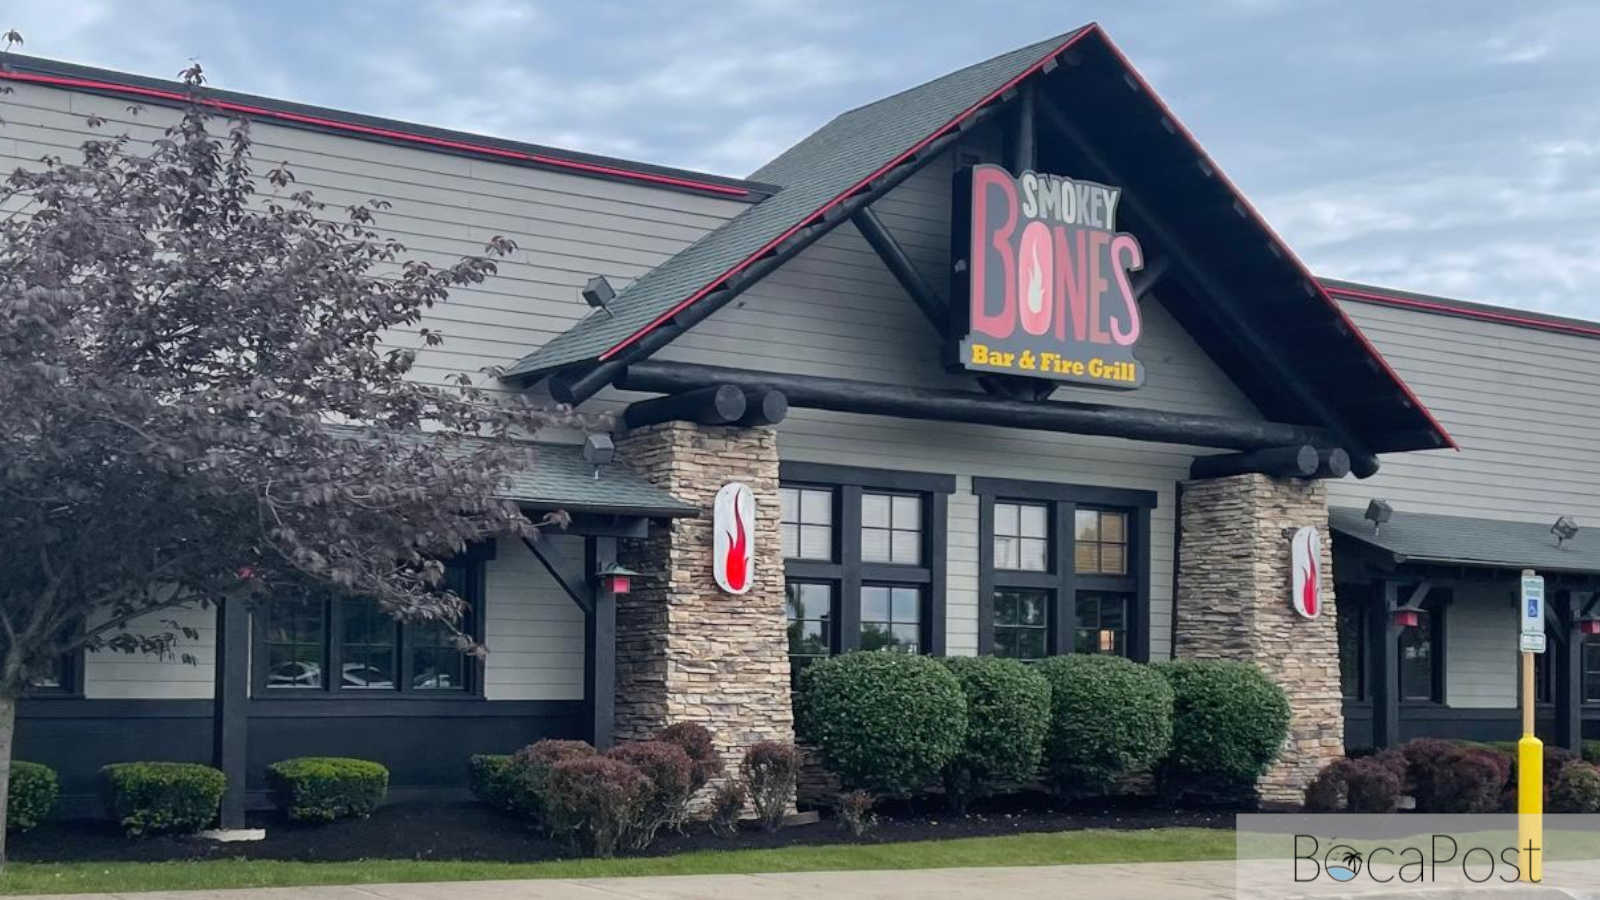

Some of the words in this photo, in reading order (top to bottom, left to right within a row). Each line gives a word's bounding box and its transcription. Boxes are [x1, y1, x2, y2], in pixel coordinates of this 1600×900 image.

[1022, 173, 1118, 230] SMOKEY
[971, 166, 1144, 346] BONES
[971, 344, 1014, 368] Bar
[1018, 350, 1036, 370] &
[1040, 352, 1084, 376] Fire
[1088, 358, 1136, 382] Grill
